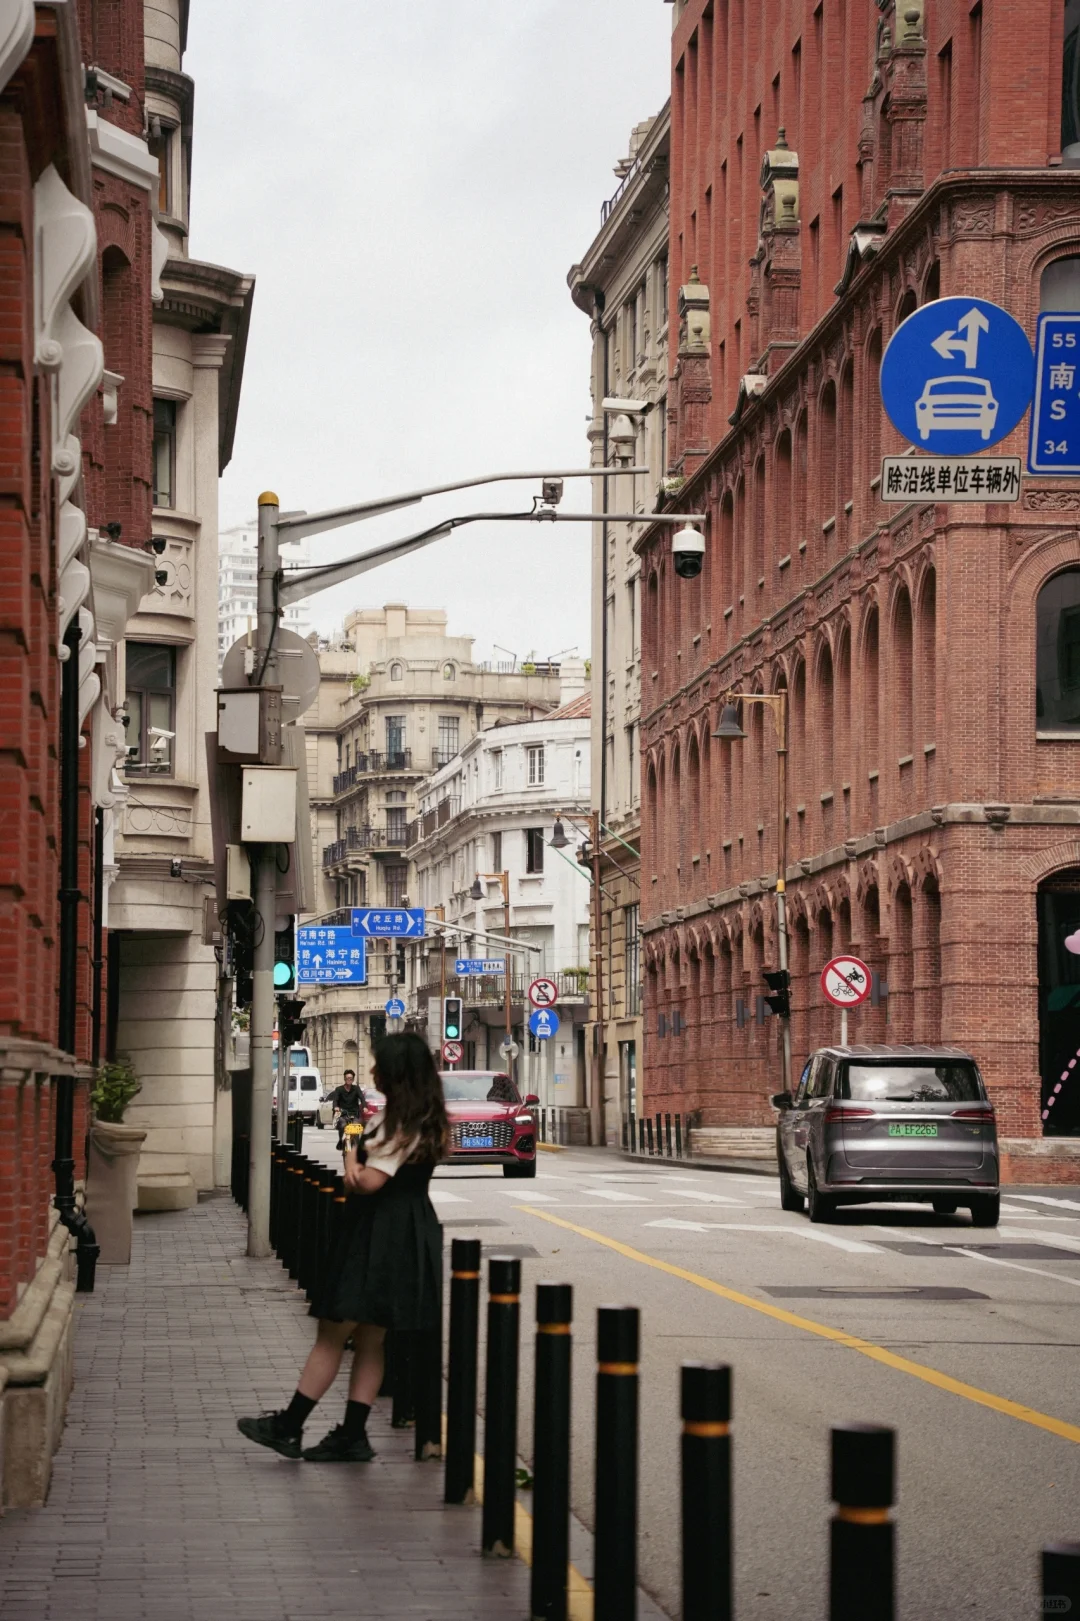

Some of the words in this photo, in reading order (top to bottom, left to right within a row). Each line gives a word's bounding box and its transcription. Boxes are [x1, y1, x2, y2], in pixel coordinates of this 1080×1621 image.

[1052, 333, 1077, 348] 55
[1049, 362, 1076, 390] 南
[1050, 399, 1067, 421] S
[1044, 440, 1068, 455] 34
[886, 465, 1019, 495] 除沿线单位车辆外
[373, 914, 402, 923] 虎丘路
[300, 930, 336, 940] 河南中路
[326, 949, 360, 958] 海宁路
[302, 970, 333, 978] 四川中路
